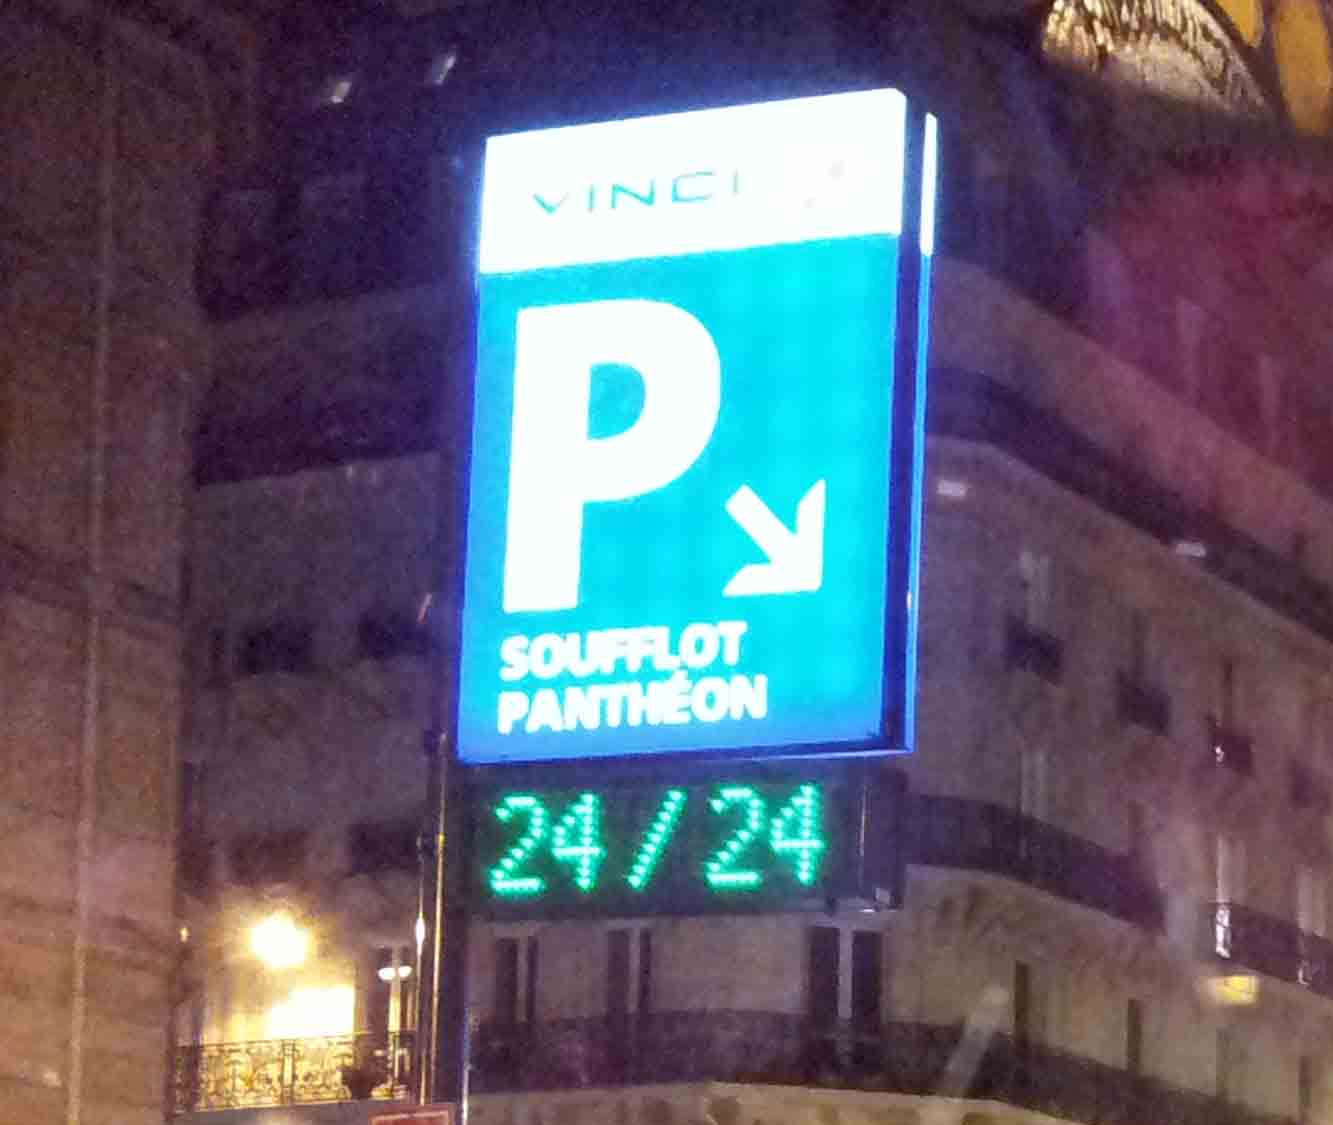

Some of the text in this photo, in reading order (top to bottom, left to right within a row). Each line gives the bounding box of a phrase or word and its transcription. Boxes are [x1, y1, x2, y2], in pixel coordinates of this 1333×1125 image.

[533, 168, 740, 214] VINCI
[503, 298, 721, 614] P
[500, 621, 748, 681] SOUFFLOT
[498, 670, 768, 734] PANTHÉON
